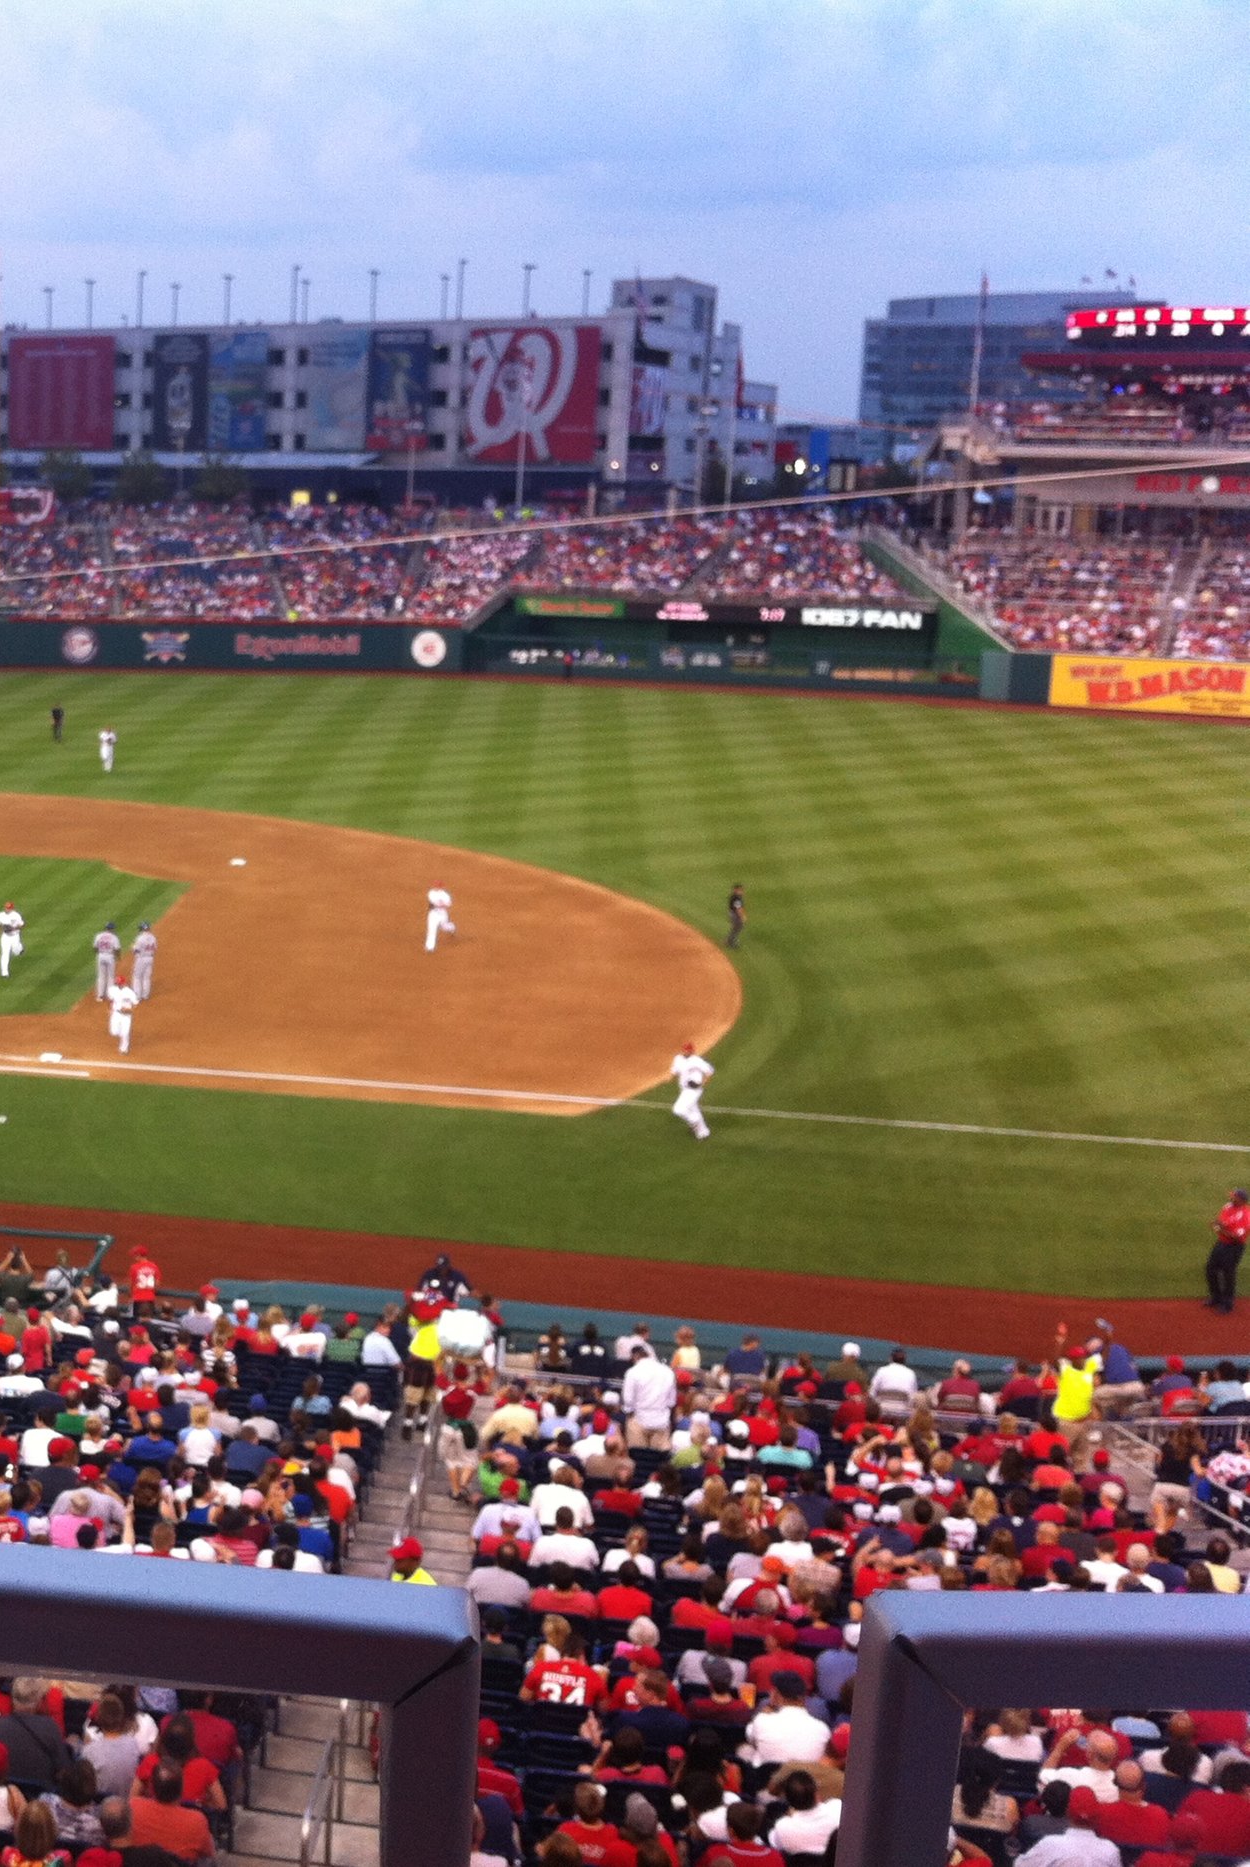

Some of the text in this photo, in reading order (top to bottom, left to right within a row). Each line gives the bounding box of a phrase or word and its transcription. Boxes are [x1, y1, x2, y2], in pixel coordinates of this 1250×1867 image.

[862, 609, 923, 630] FAN
[234, 633, 362, 660] ExxonMobil
[1140, 666, 1247, 698] MASON
